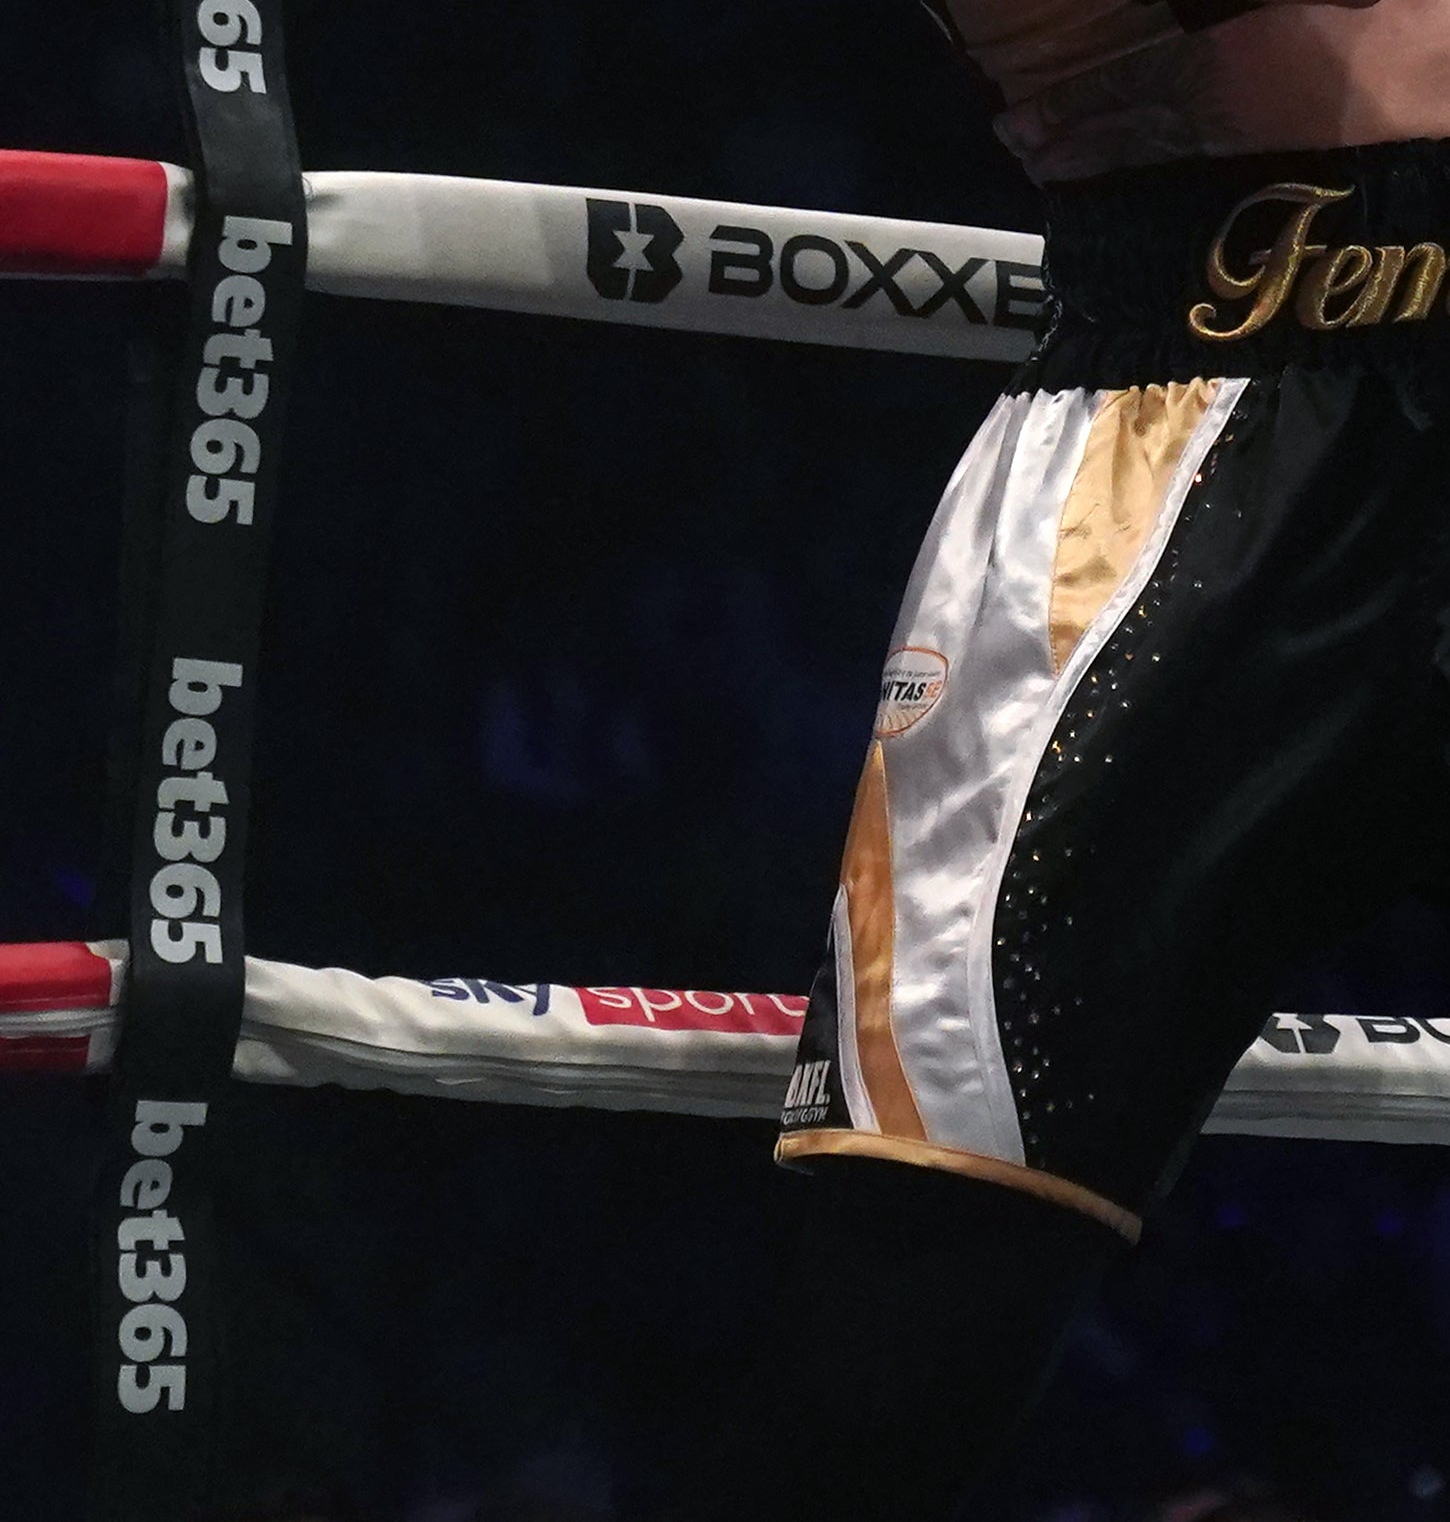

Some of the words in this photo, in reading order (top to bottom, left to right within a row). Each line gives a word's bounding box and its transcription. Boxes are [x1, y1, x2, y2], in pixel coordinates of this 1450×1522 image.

[185, 215, 293, 527] bet365
[149, 657, 244, 966] bet365
[117, 1099, 208, 1415] bet365
